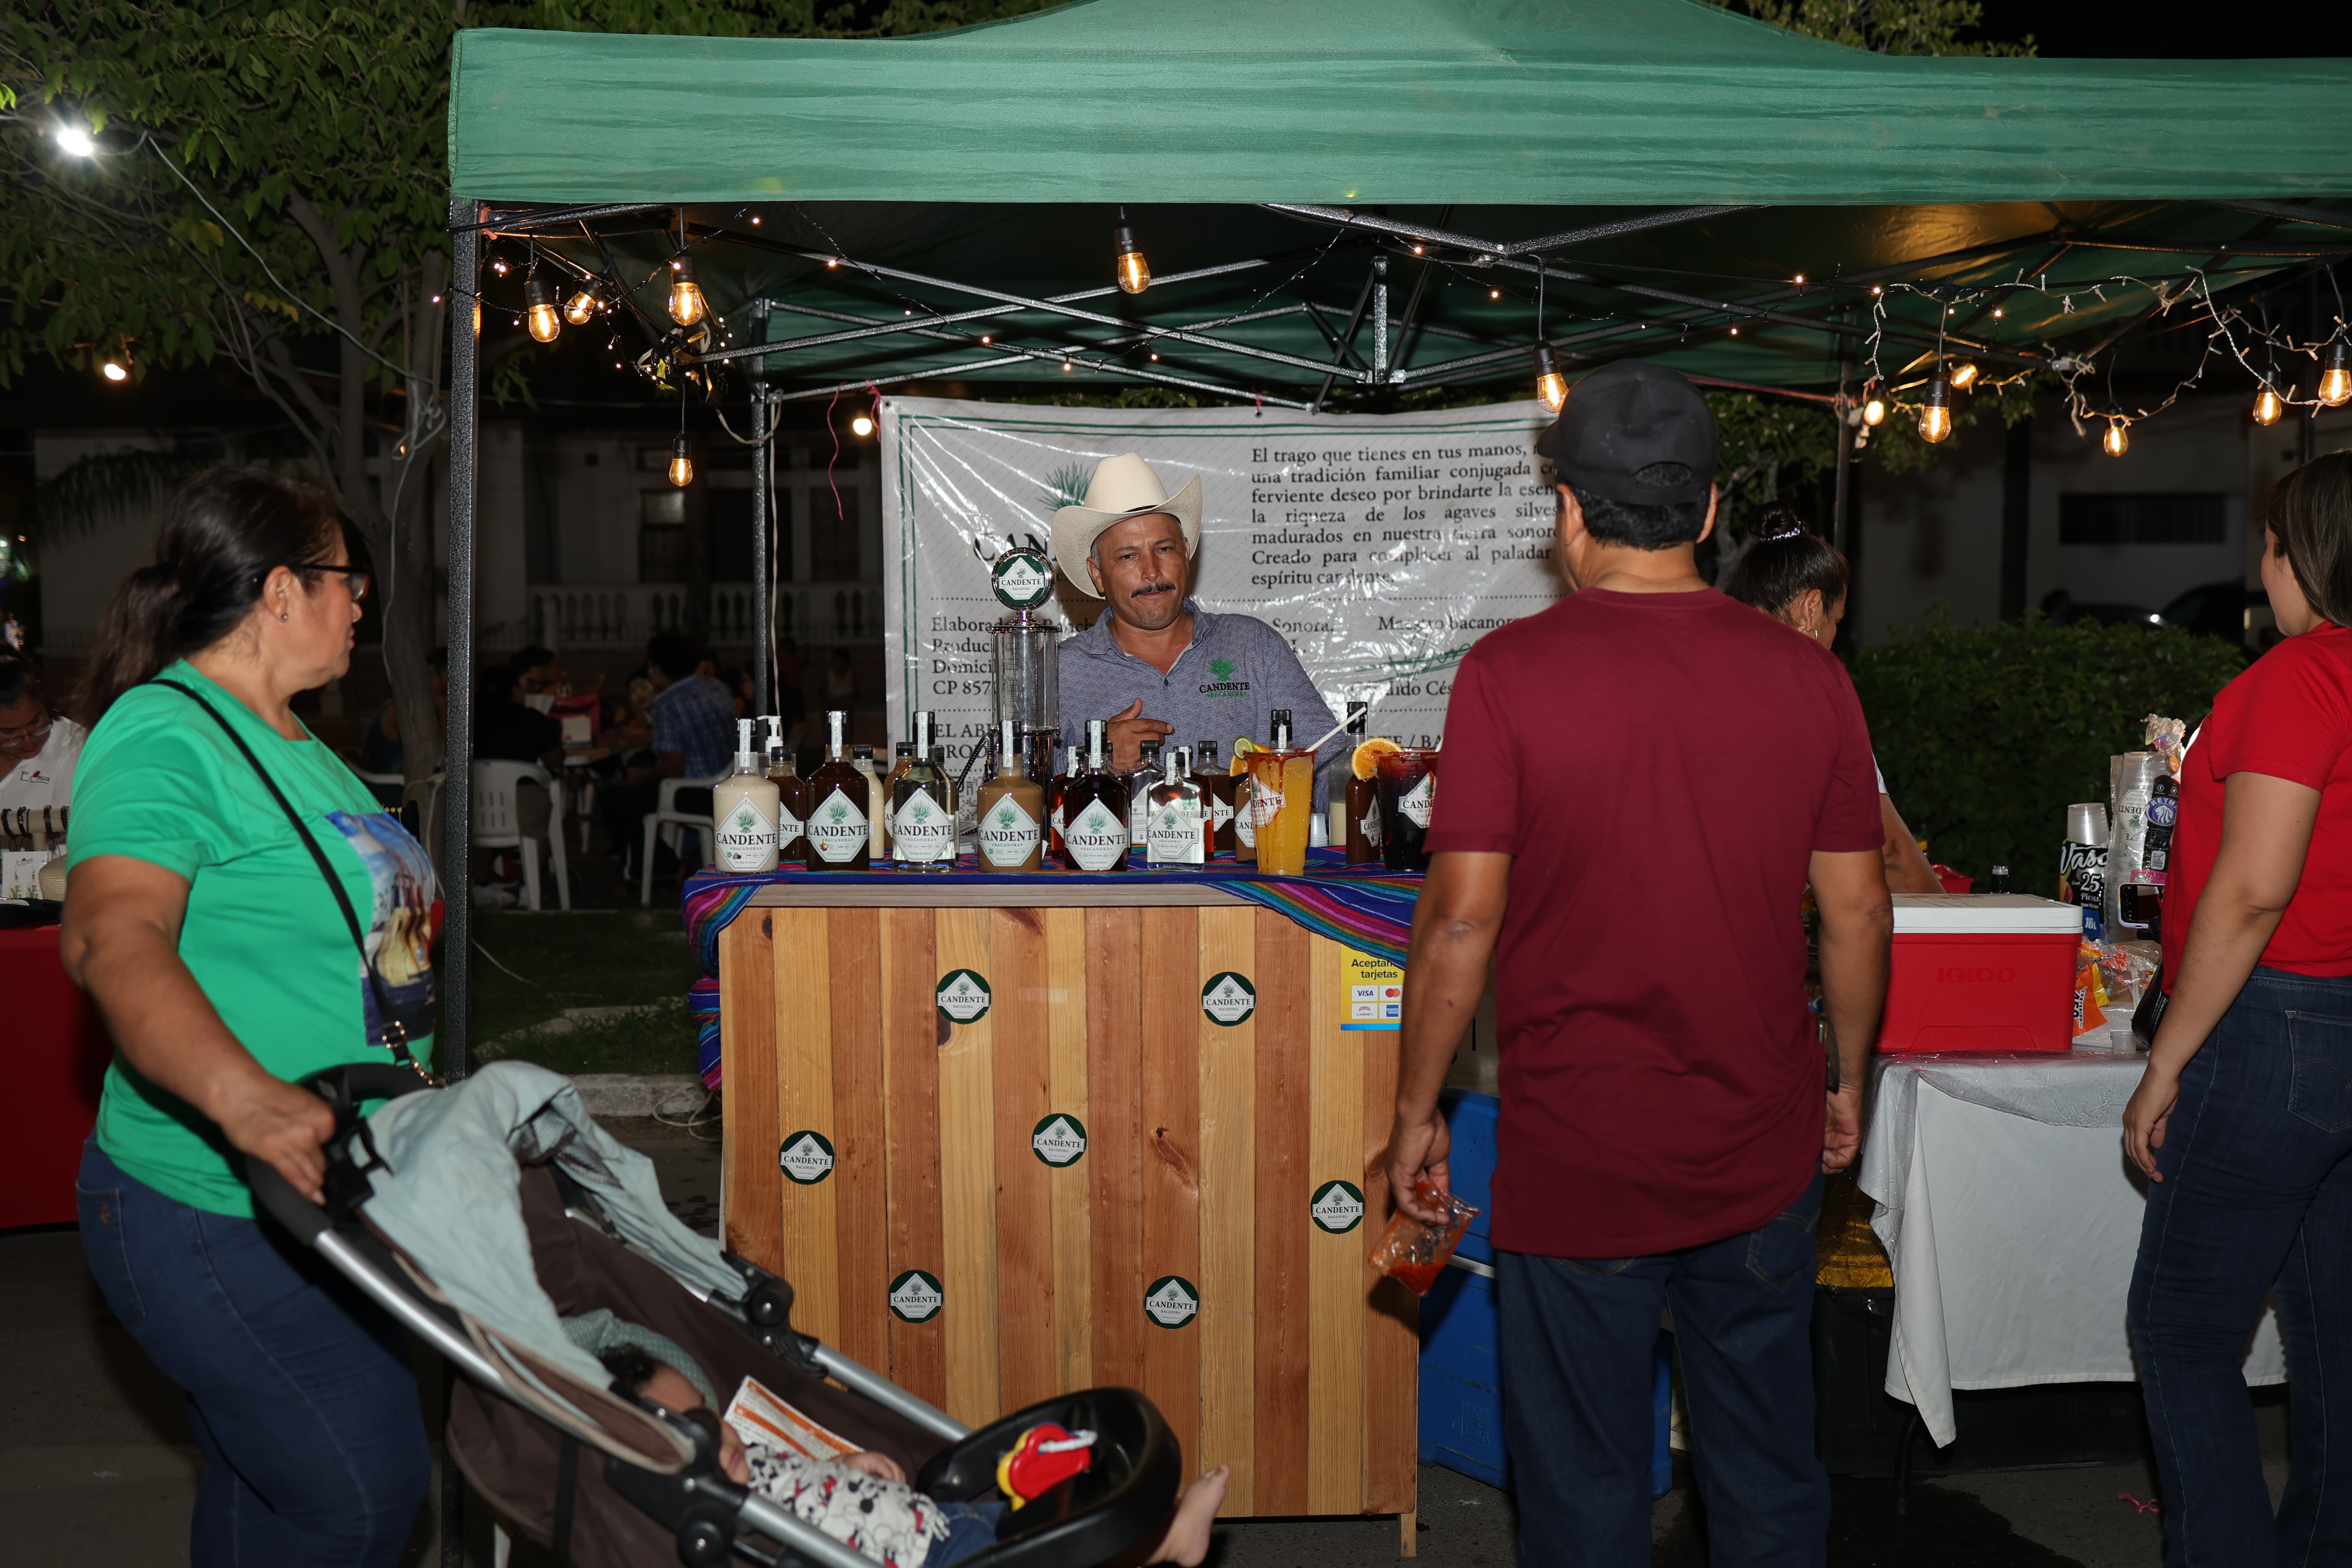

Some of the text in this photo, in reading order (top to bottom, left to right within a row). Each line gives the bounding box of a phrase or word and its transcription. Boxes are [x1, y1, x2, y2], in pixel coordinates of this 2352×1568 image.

[1252, 448, 1268, 462] El
[1274, 450, 1316, 466] trago
[1323, 450, 1352, 466] que
[1358, 447, 1406, 461] tienes
[1412, 449, 1431, 460] en
[1438, 447, 1462, 459] tus
[1468, 444, 1527, 458] manos,
[1252, 473, 1282, 483] una
[1291, 467, 1366, 483] tradición
[1376, 466, 1440, 481] familiar
[1450, 461, 1531, 481] conjugada
[1252, 482, 1554, 505] ferviente deseo por brindarte la esen
[1252, 502, 1558, 527] la riqueza de los agaves silves
[1252, 528, 1343, 544] madurados
[1354, 531, 1372, 542] en
[1382, 527, 1441, 541] nuestra
[1507, 527, 1557, 538] sonor
[1252, 549, 1311, 564] Creado
[1323, 551, 1358, 567] para
[1466, 545, 1479, 560] al
[1491, 544, 1552, 564] paladar
[1252, 570, 1313, 589] espíritu
[931, 616, 1006, 631] Elaborad
[1273, 618, 1333, 632] Sonora.
[1449, 614, 1514, 629] bacanor
[932, 637, 995, 652] Produc
[932, 658, 996, 674] Domicil
[933, 680, 997, 695] CP 857
[1199, 682, 1250, 693] CANDENTE
[1426, 680, 1453, 695] Cés
[935, 724, 957, 738] EL
[1403, 799, 1434, 808] CANDE
[808, 824, 867, 836] CANDENTE
[893, 824, 952, 836] CANDENTE
[979, 830, 1038, 841] CANDENTE
[1147, 830, 1196, 839] CANDENTE
[716, 833, 776, 845] CANDENTE
[1066, 834, 1126, 845] CANDENTE
[2080, 872, 2101, 892] 25
[1351, 959, 1395, 969] Acepta
[1360, 970, 1398, 980] tarjetas
[1938, 967, 2016, 983] IGLOO
[1037, 1138, 1081, 1148] CANDENTE
[784, 1155, 829, 1166] CANDENTE
[1149, 1300, 1194, 1310] CANDENTE
